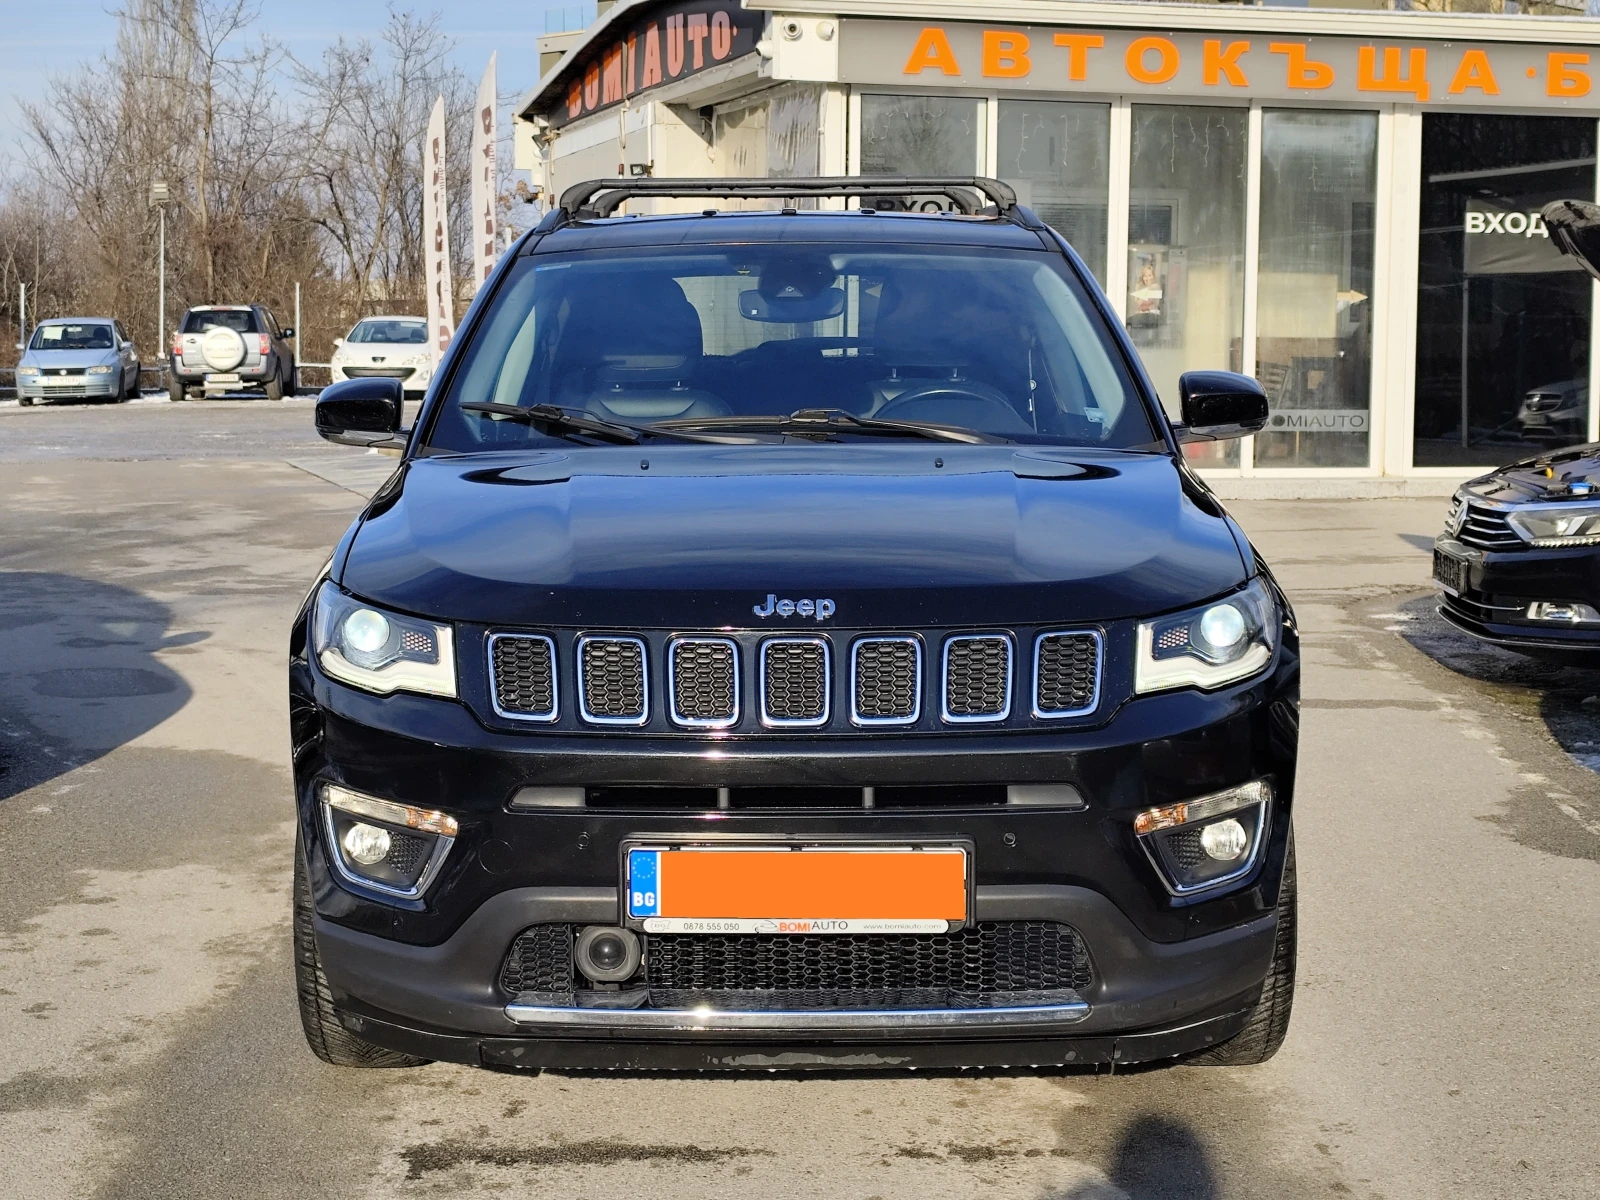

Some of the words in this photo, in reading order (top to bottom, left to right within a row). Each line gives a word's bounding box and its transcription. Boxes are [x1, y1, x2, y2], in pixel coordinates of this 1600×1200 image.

[903, 27, 1500, 102] АВТОКЪЩА
[753, 593, 836, 621] Jeep
[633, 891, 656, 907] BG
[683, 922, 704, 931] 0878
[706, 922, 722, 931] 555
[724, 922, 740, 931] 050
[863, 920, 942, 930] www.bomiauto.com
